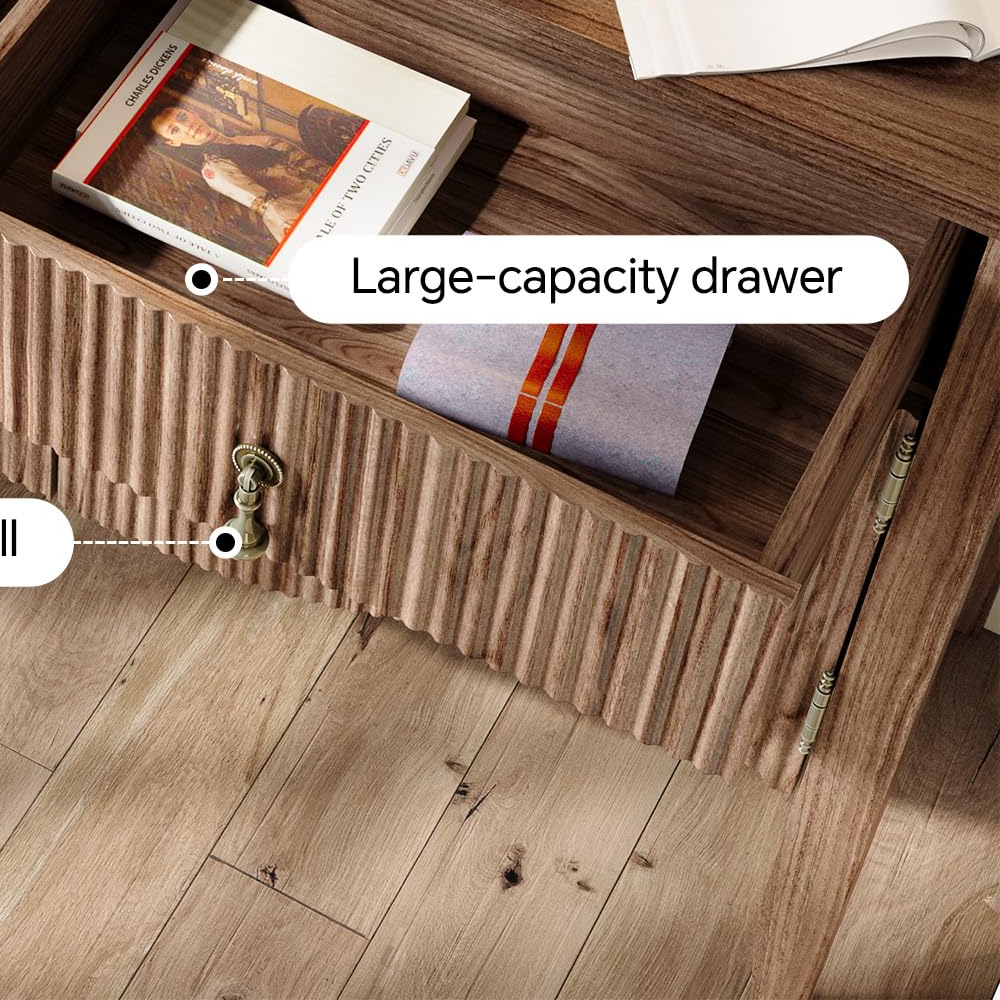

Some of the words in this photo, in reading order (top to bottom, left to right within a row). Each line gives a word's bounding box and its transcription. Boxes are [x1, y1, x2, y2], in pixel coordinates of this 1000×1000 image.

[125, 74, 154, 107] CHARLES
[149, 43, 178, 76] DICKENS
[330, 202, 347, 220] OF
[342, 174, 367, 202] TWO
[362, 136, 393, 174] CITIES
